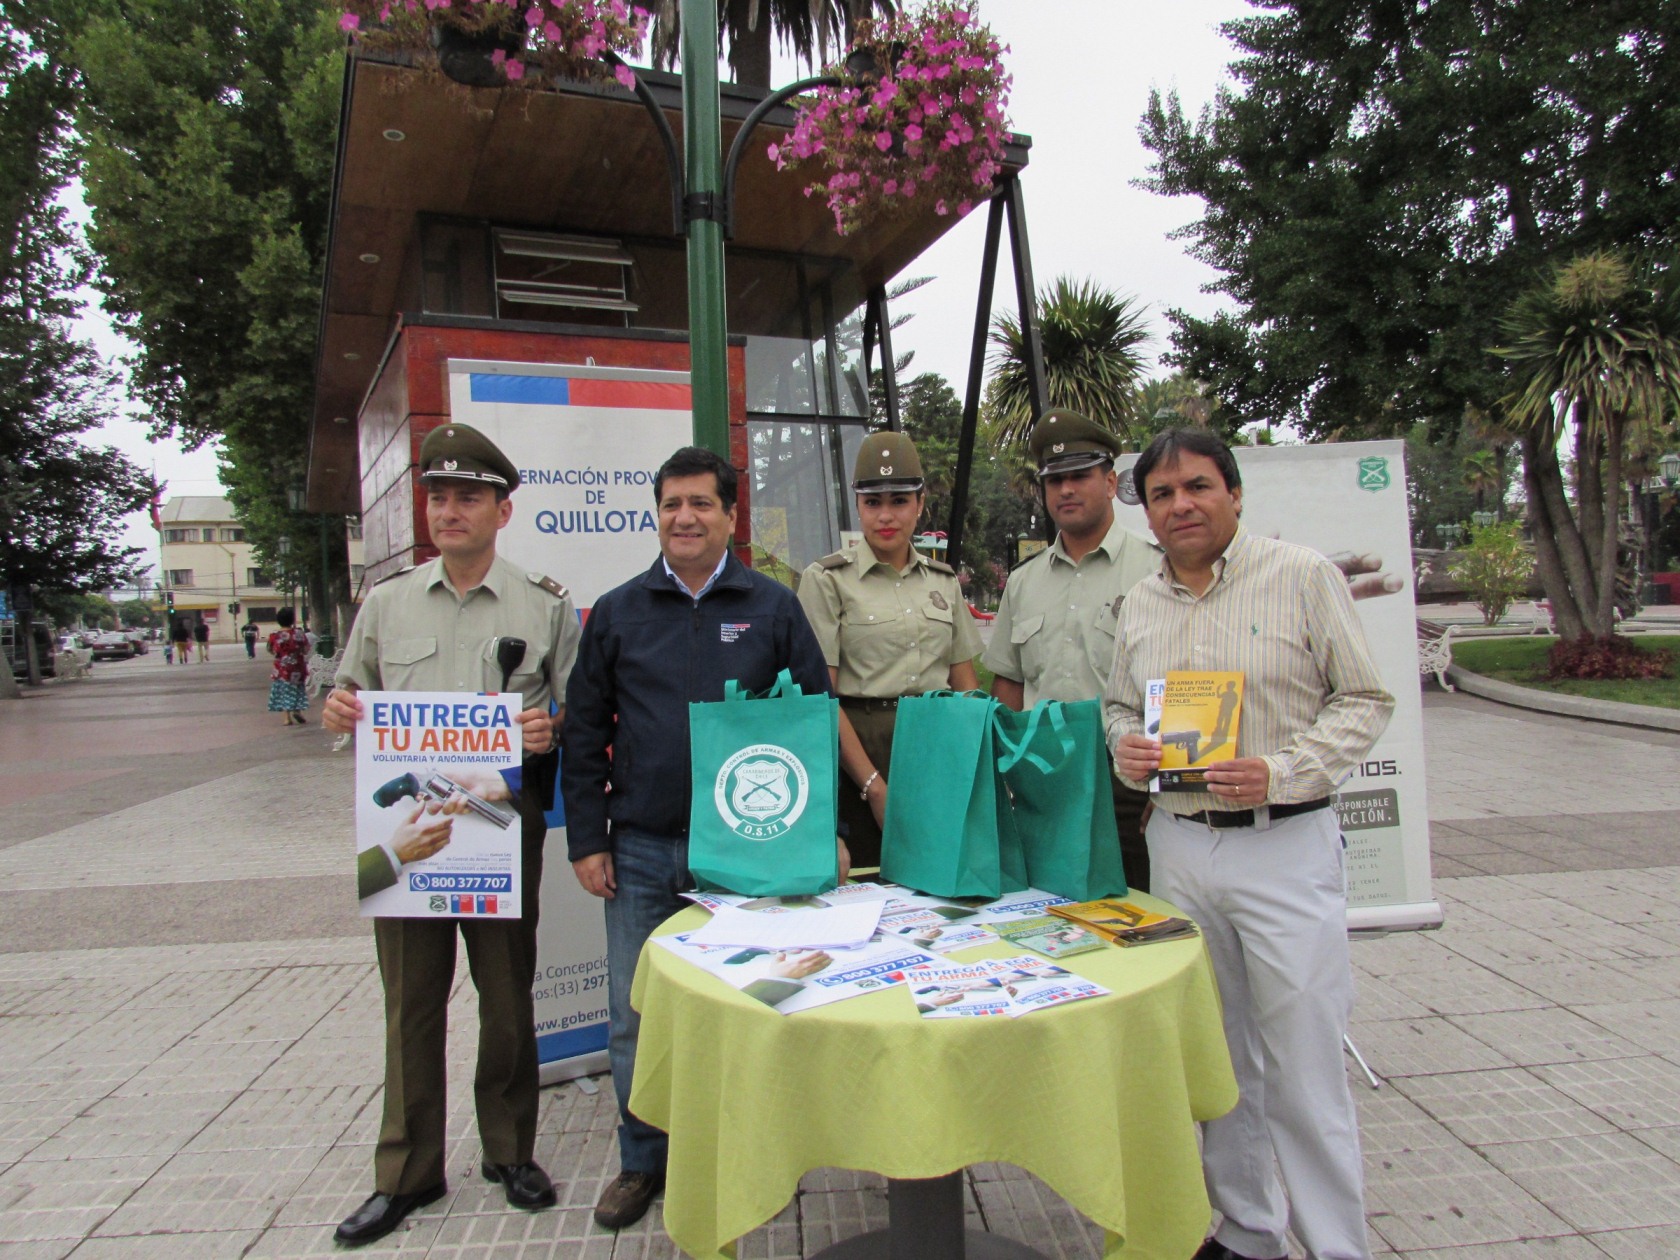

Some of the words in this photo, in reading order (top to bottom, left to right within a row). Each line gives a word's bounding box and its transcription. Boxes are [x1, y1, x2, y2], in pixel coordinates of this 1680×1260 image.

[586, 490, 605, 504] DE
[535, 510, 658, 535] QUILLOTA
[373, 703, 512, 727] ENTREGA
[373, 727, 411, 751] TU
[420, 728, 511, 752] ARMA
[372, 754, 427, 762] VOLUNTARIA
[428, 754, 435, 763] Y
[438, 754, 511, 763] ANÓNIMAMENTE
[727, 751, 749, 769] CONTROL
[785, 755, 805, 785] EXPLOSIVOS
[431, 877, 455, 888] 800
[458, 877, 481, 888] 377
[484, 877, 508, 888] 707
[841, 968, 871, 980] 800
[870, 962, 897, 973] 377
[897, 956, 923, 966] 707
[908, 965, 987, 978] ENTREGA
[534, 971, 542, 982] a
[938, 971, 989, 980] ARMA
